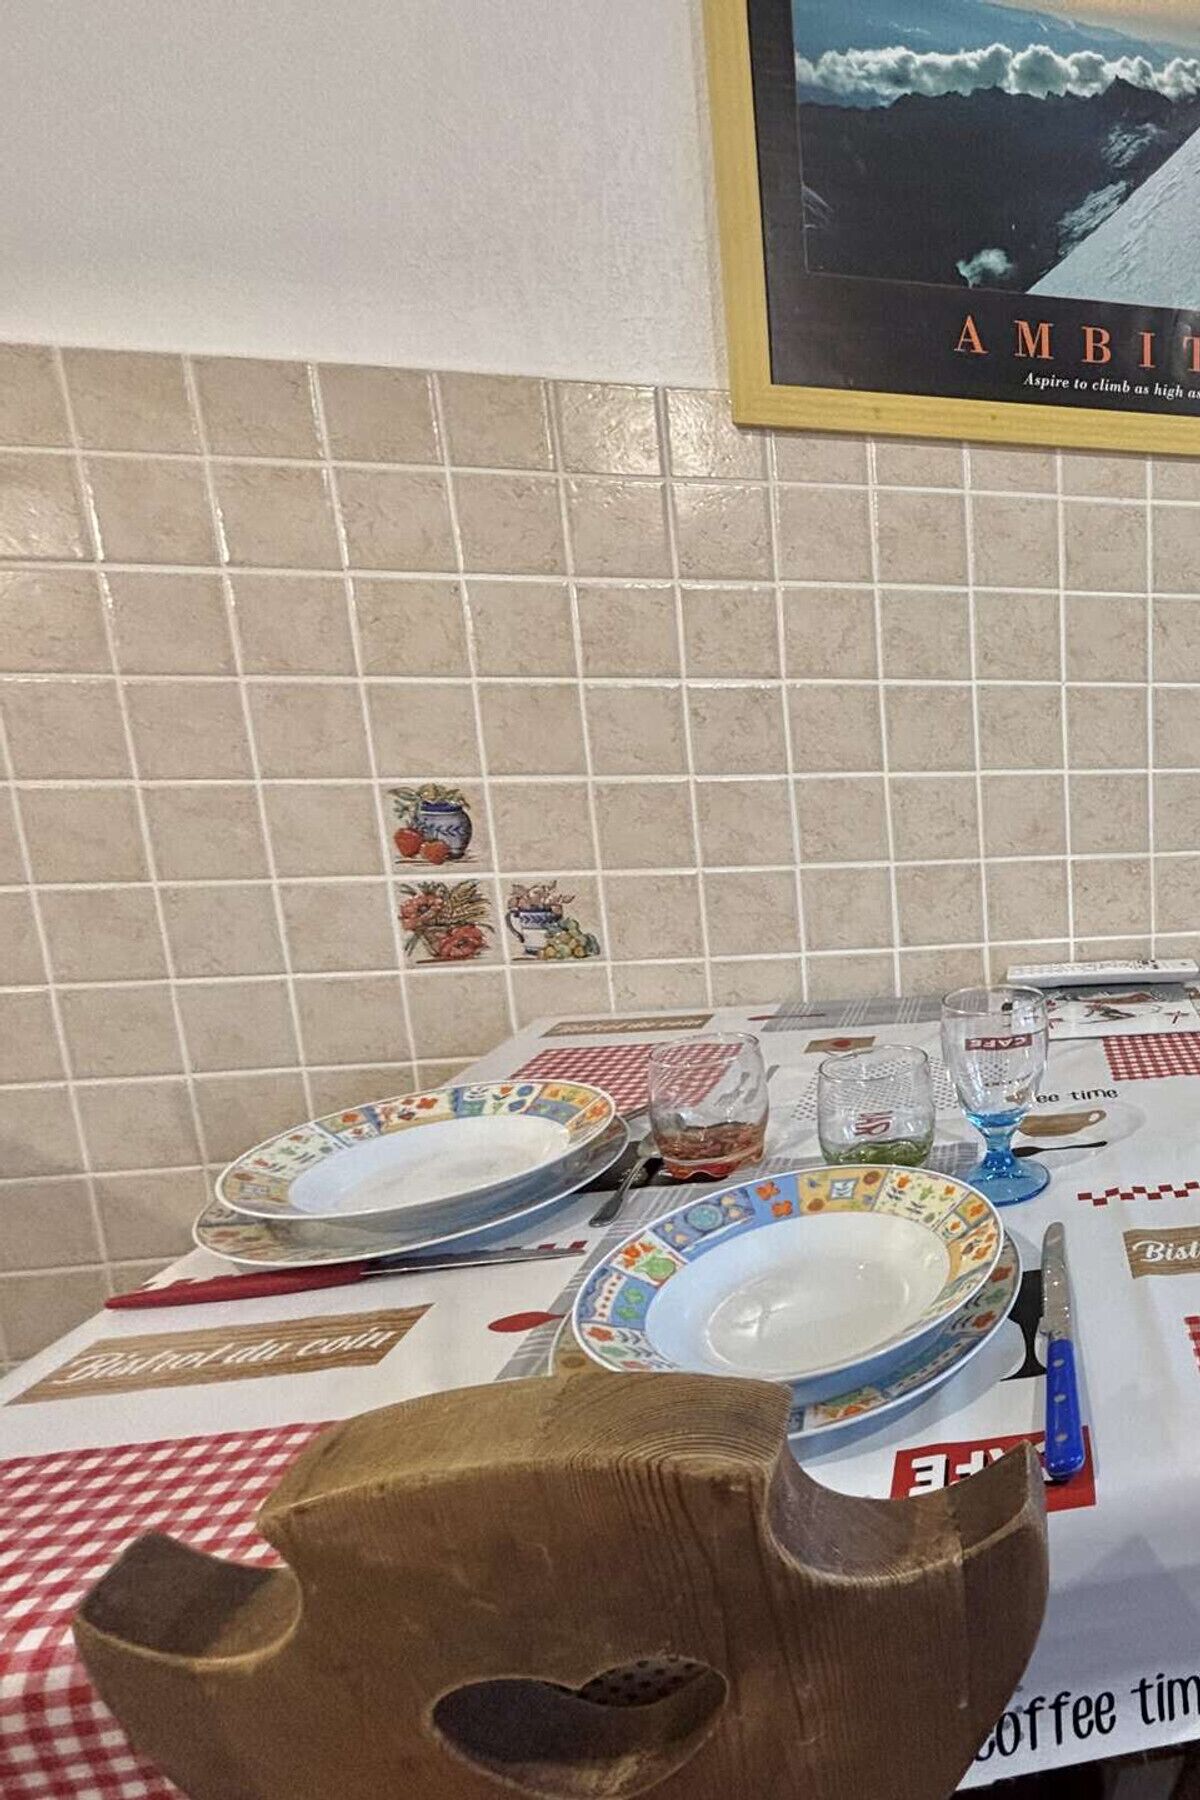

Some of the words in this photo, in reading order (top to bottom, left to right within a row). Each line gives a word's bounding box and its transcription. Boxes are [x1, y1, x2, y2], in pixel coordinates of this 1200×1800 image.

[1023, 373, 1070, 390] Aspire
[1074, 379, 1088, 390] to
[1092, 380, 1130, 394] climb
[1134, 386, 1149, 395] as
[1154, 382, 1183, 400] high
[1070, 1088, 1119, 1101] time
[224, 1339, 290, 1364] du
[297, 1327, 397, 1357] coin
